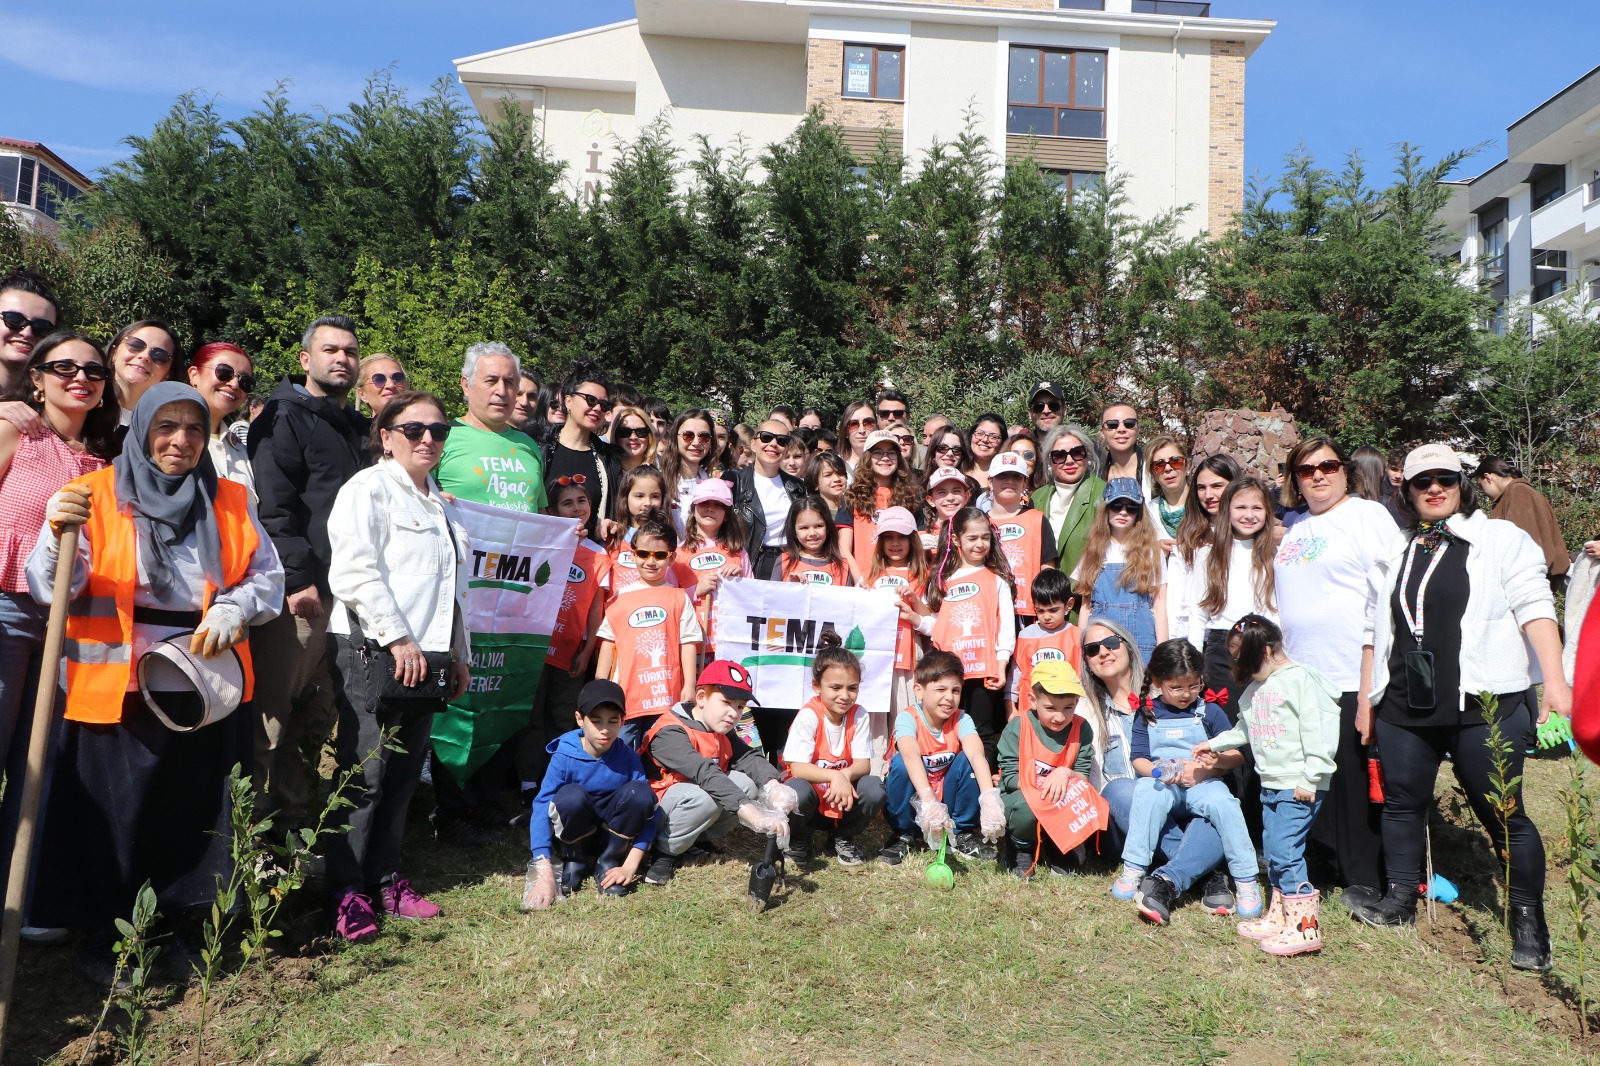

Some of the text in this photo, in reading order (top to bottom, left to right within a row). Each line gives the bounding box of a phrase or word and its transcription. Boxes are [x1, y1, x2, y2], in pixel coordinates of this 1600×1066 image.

[480, 456, 527, 473] TEMA
[486, 473, 530, 499] Ağaç
[999, 526, 1017, 535] TEMA
[473, 550, 531, 581] TEMA
[697, 555, 718, 564] TEMA
[806, 573, 825, 582] TEMA
[881, 578, 899, 586] TEMA
[950, 585, 971, 596] TEMA
[636, 609, 659, 621] TEMA
[746, 615, 837, 654] TEMA
[952, 638, 986, 652] TÜRKİYE
[962, 649, 978, 663] ÇÖL
[1036, 651, 1056, 661] TEMA
[963, 662, 986, 673] MASIN
[637, 667, 672, 685] TÜRKİYE
[650, 681, 669, 698] ÇÖL
[927, 756, 948, 767] TEMA
[1034, 763, 1052, 776] EMA
[1054, 779, 1090, 811] TÜRKİYE
[1070, 796, 1090, 816] ÇÖL
[1068, 806, 1099, 834] OLMAS
